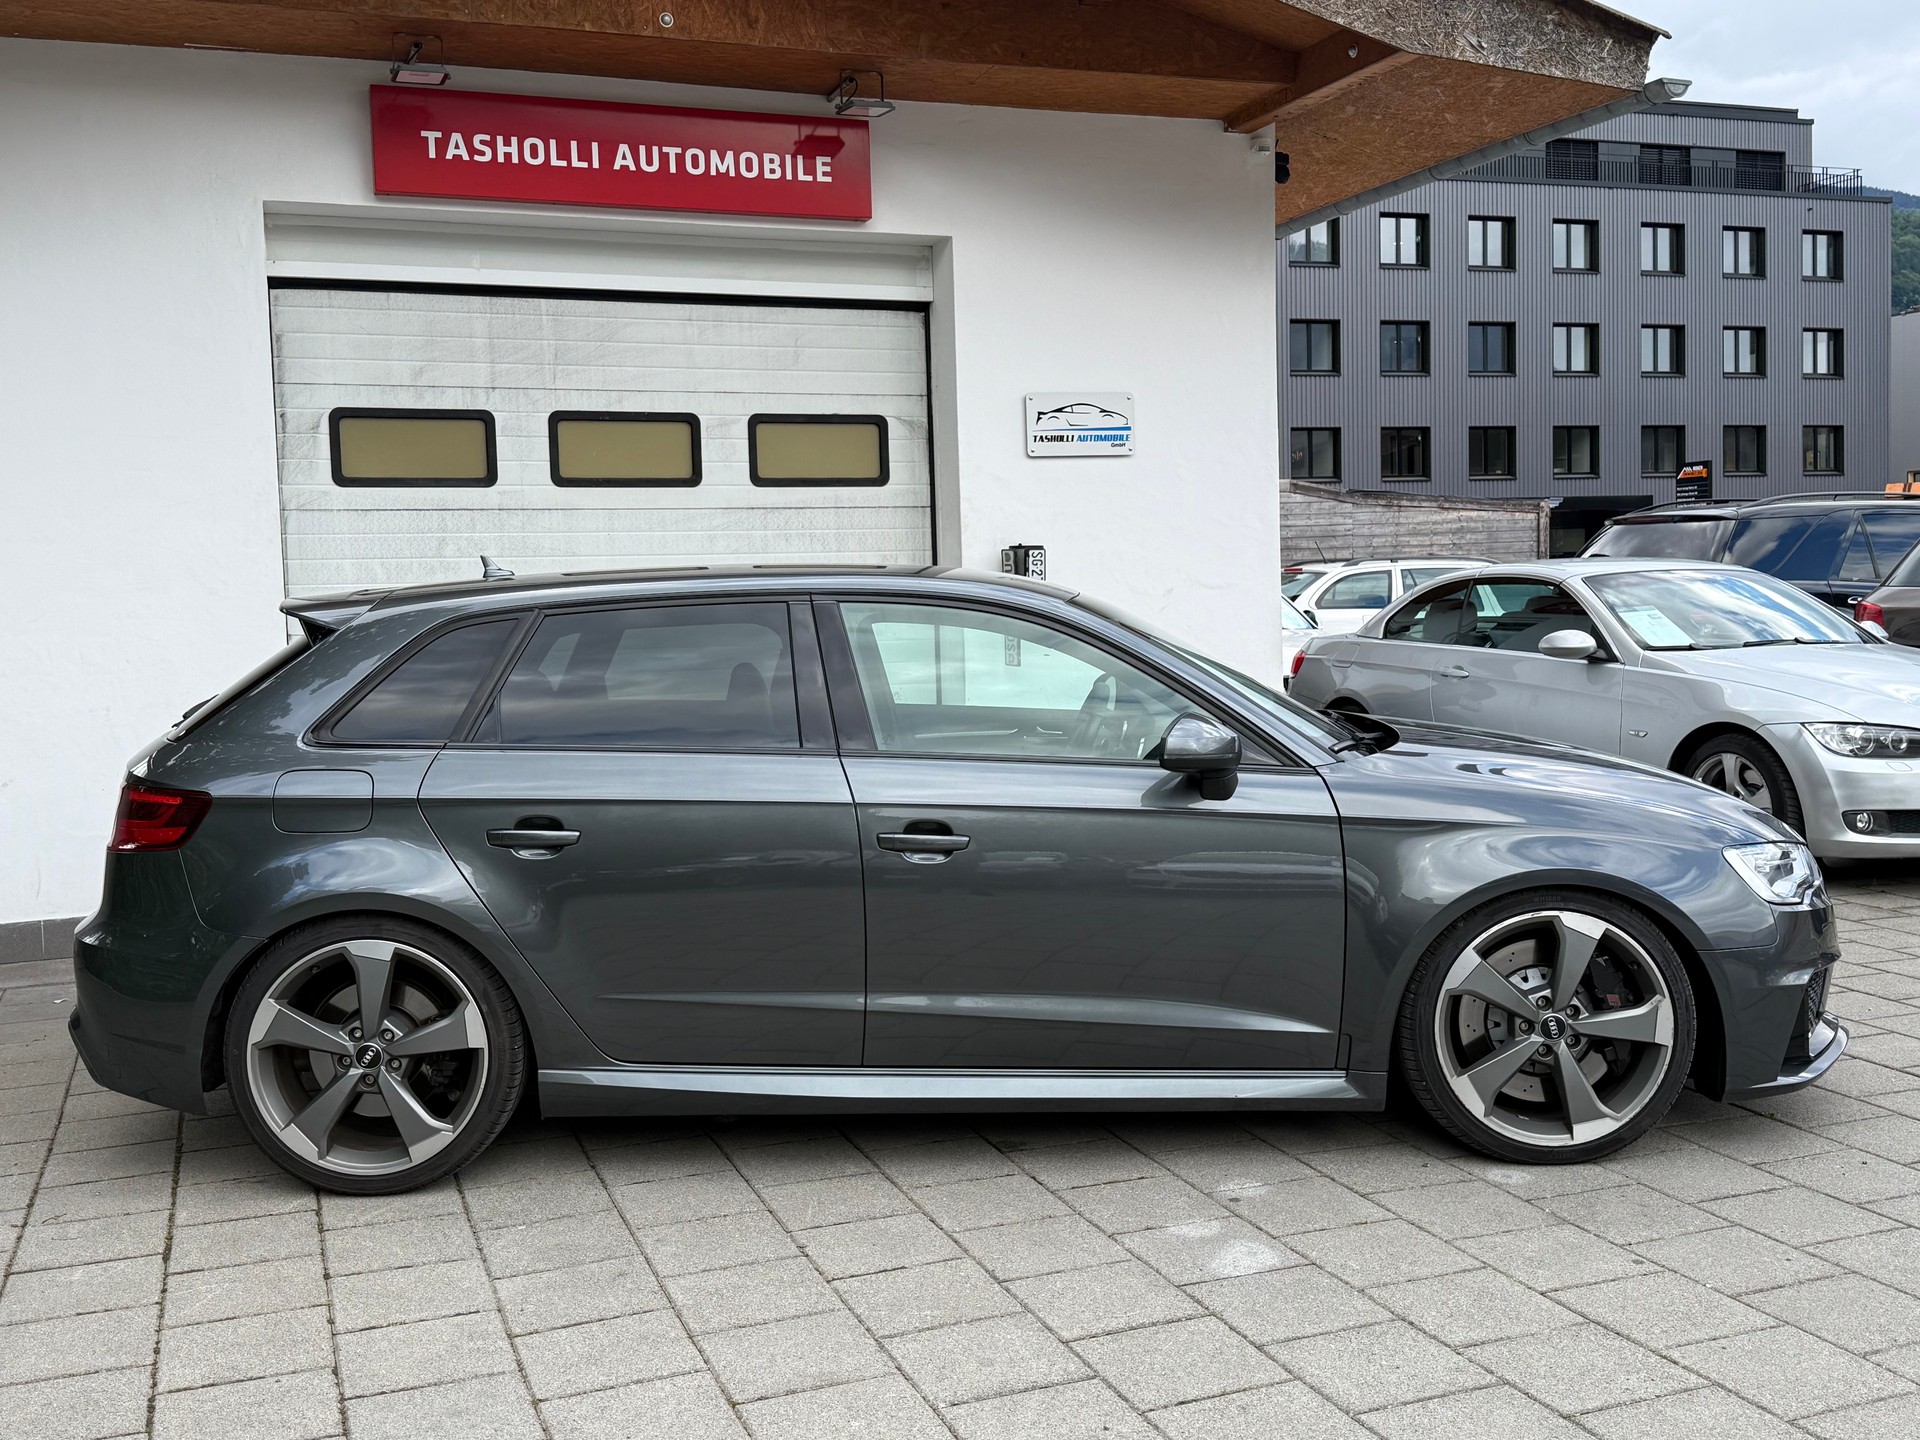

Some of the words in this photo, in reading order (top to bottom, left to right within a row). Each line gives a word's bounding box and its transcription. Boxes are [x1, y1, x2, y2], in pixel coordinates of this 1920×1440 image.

[420, 130, 600, 170] TASHOLLI
[612, 143, 834, 184] AUTOMOBILE
[1032, 434, 1075, 443] TASHOLLI
[1076, 433, 1131, 443] AUTOMOBILE
